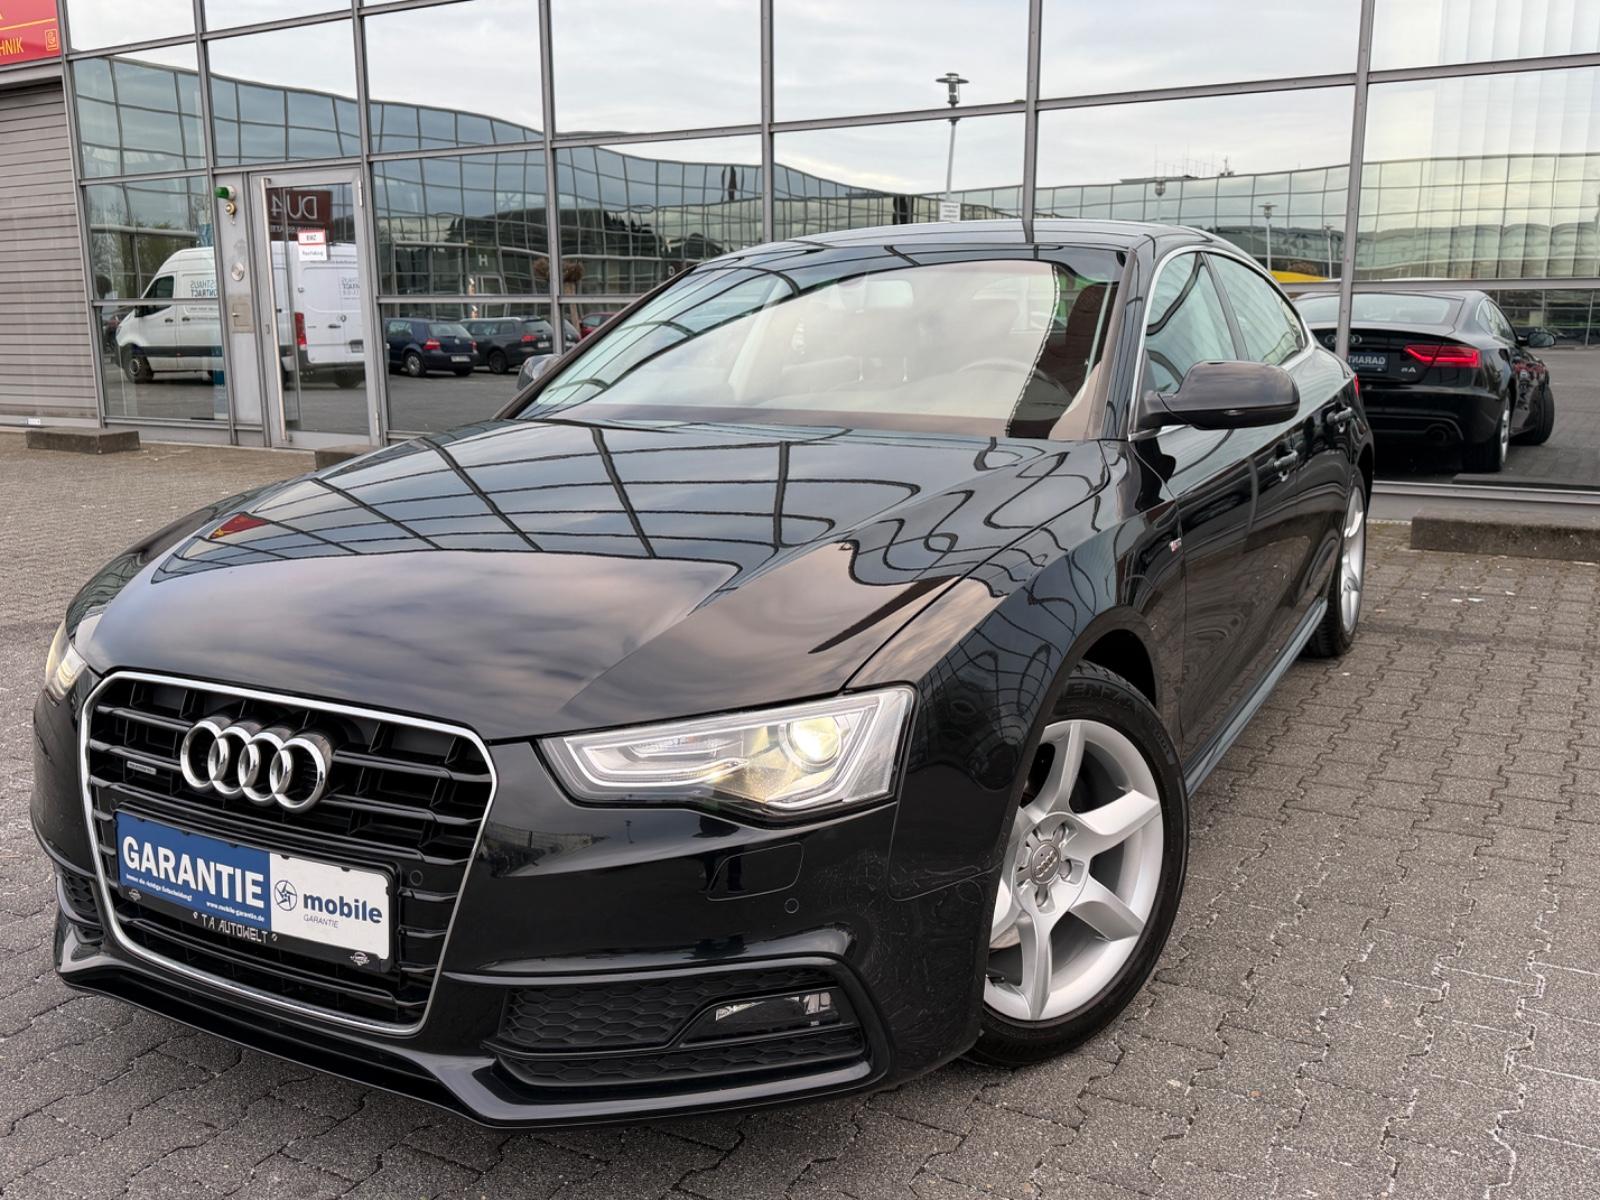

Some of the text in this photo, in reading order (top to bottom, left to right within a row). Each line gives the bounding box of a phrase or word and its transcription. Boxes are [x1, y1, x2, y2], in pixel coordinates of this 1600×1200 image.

[122, 836, 264, 909] GARANTIE
[206, 901, 265, 923] www.mobile-garantie.de
[303, 893, 383, 924] mobile
[217, 919, 268, 944] AUTOWELT
[303, 914, 339, 929] GARANTIE
